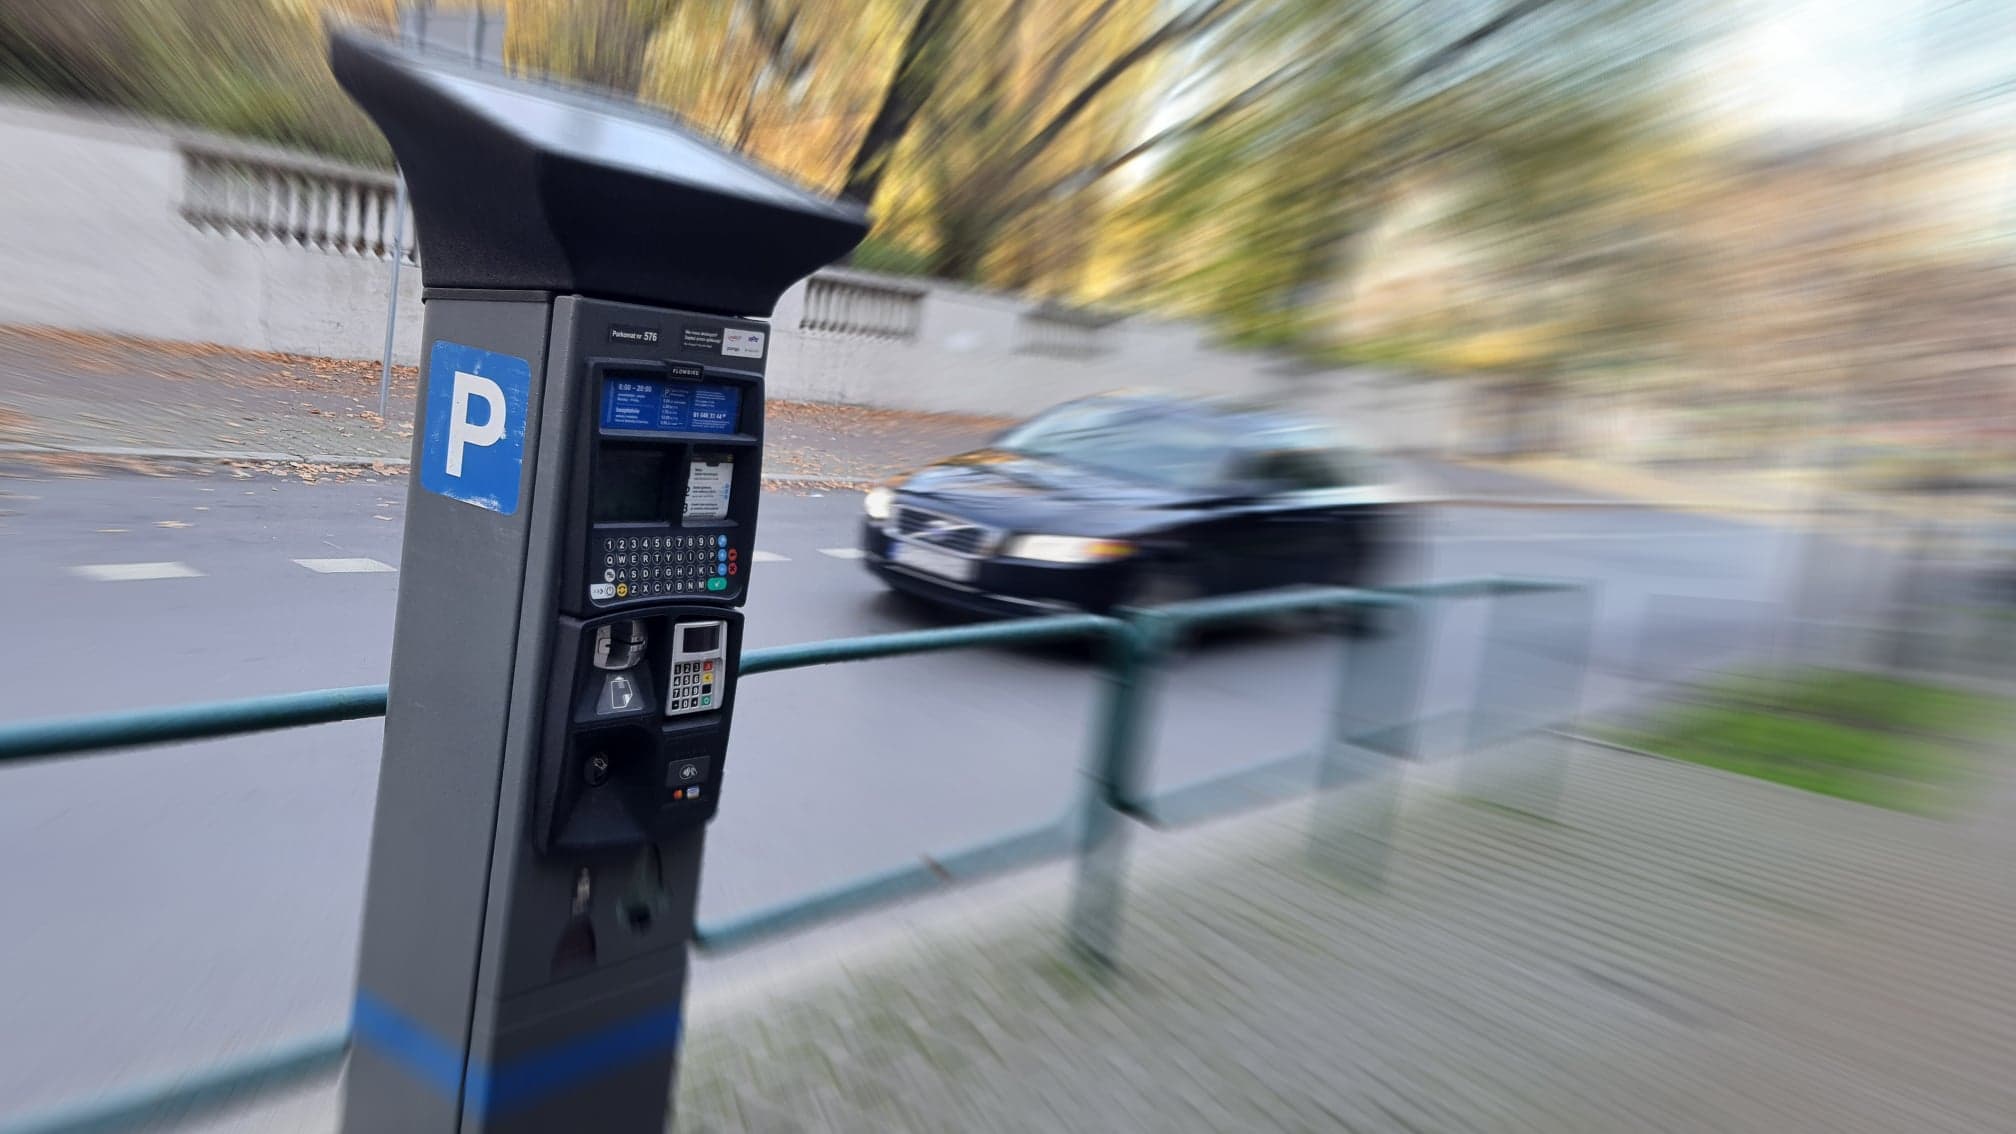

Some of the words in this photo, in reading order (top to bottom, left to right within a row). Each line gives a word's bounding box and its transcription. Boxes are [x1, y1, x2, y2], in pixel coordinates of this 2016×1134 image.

[612, 330, 635, 339] Parkomat
[643, 331, 657, 342] 576
[446, 371, 506, 478] P
[608, 540, 612, 549] 1
[619, 540, 625, 549] 2
[631, 539, 637, 549] 3
[643, 539, 648, 548] 4
[654, 539, 660, 548] 5
[666, 538, 671, 547] 6
[677, 538, 682, 547] 7
[688, 537, 693, 547] 8
[698, 537, 704, 546] 9
[709, 537, 715, 546] 0
[606, 556, 613, 565] Q
[618, 555, 626, 564] W
[631, 555, 637, 563] E
[643, 554, 649, 563] R
[654, 554, 660, 562] T
[665, 553, 671, 562] Y
[677, 553, 682, 561] U
[689, 552, 692, 561] I
[698, 552, 704, 560] O
[709, 551, 715, 560] P
[619, 570, 625, 579] A
[631, 570, 637, 578] S
[643, 569, 649, 578] D
[655, 569, 660, 577] F
[665, 568, 671, 576] G
[677, 568, 683, 576] H
[688, 567, 693, 575] J
[698, 566, 704, 575] K
[709, 566, 715, 574] L
[631, 585, 637, 594] Z
[643, 584, 649, 593] X
[654, 584, 660, 592] C
[665, 583, 671, 591] V
[677, 582, 683, 591] B
[688, 581, 694, 590] N
[698, 581, 705, 589] M
